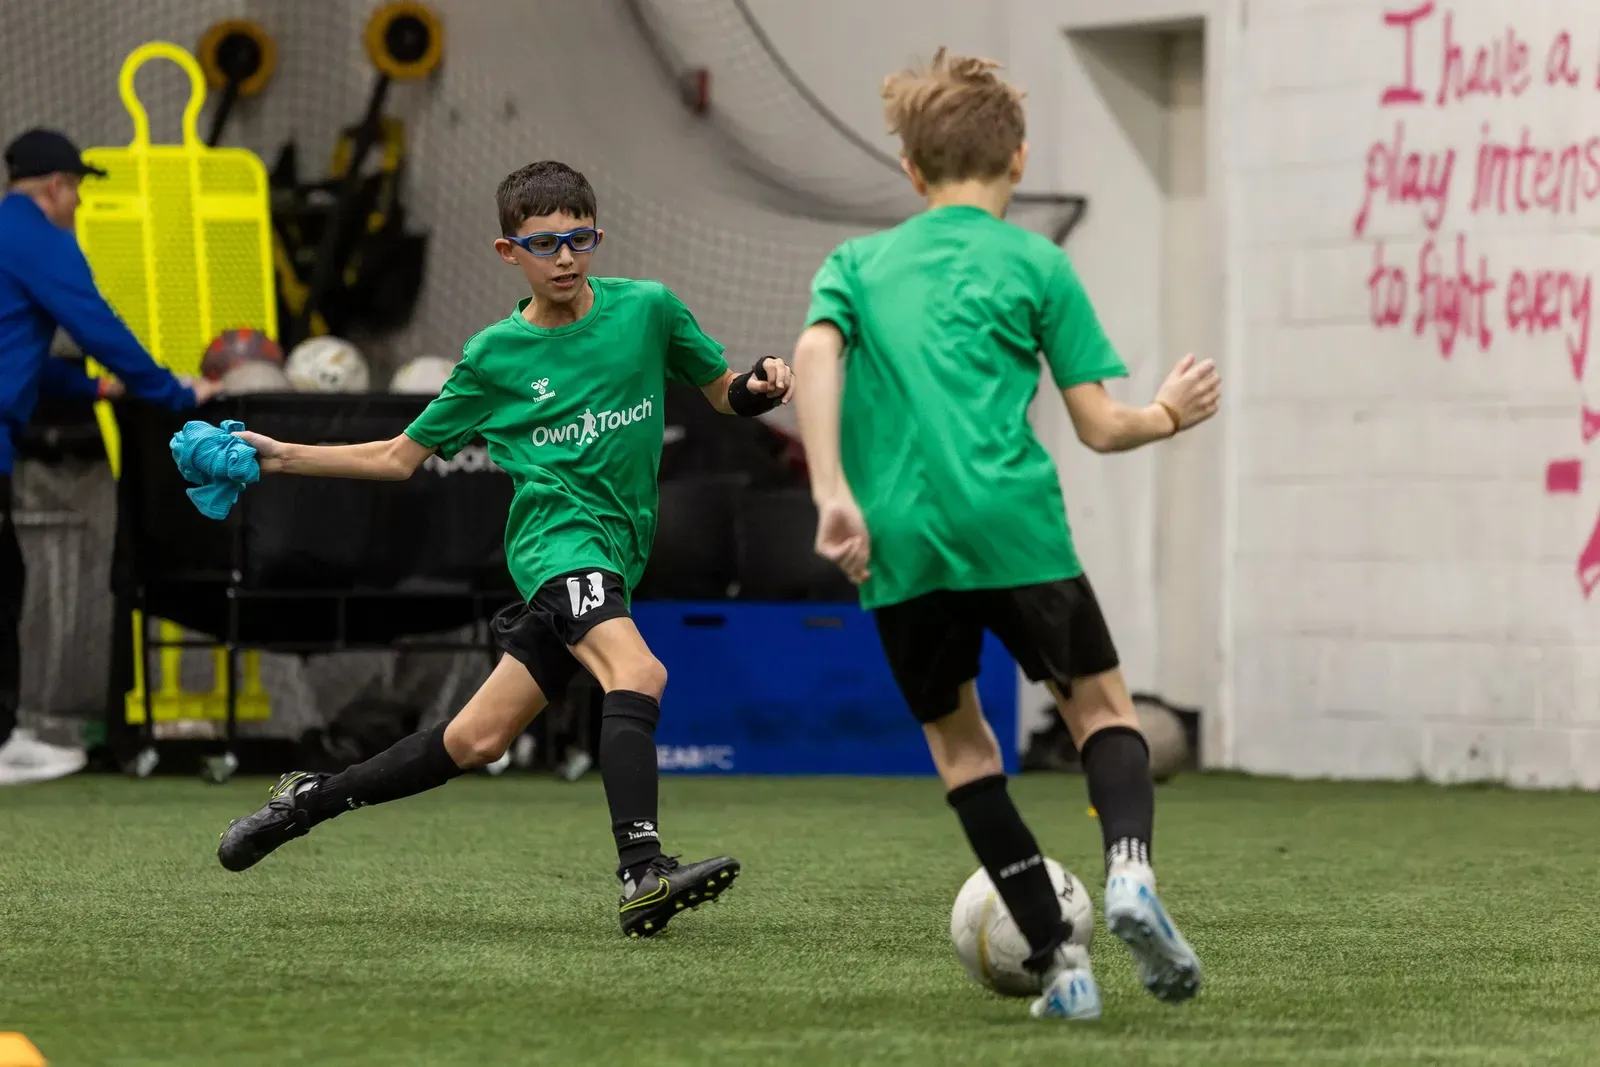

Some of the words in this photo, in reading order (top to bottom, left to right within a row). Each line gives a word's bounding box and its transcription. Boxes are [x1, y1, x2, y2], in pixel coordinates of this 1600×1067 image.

[1380, 1, 1435, 107] I
[1437, 9, 1531, 107] have
[1546, 30, 1581, 87] a
[1353, 119, 1456, 240] play
[1367, 239, 1406, 329] to
[1413, 232, 1496, 360] fight
[1505, 266, 1592, 382] every
[532, 423, 579, 447] Own
[597, 397, 652, 432] Touch
[533, 390, 556, 403] hummel
